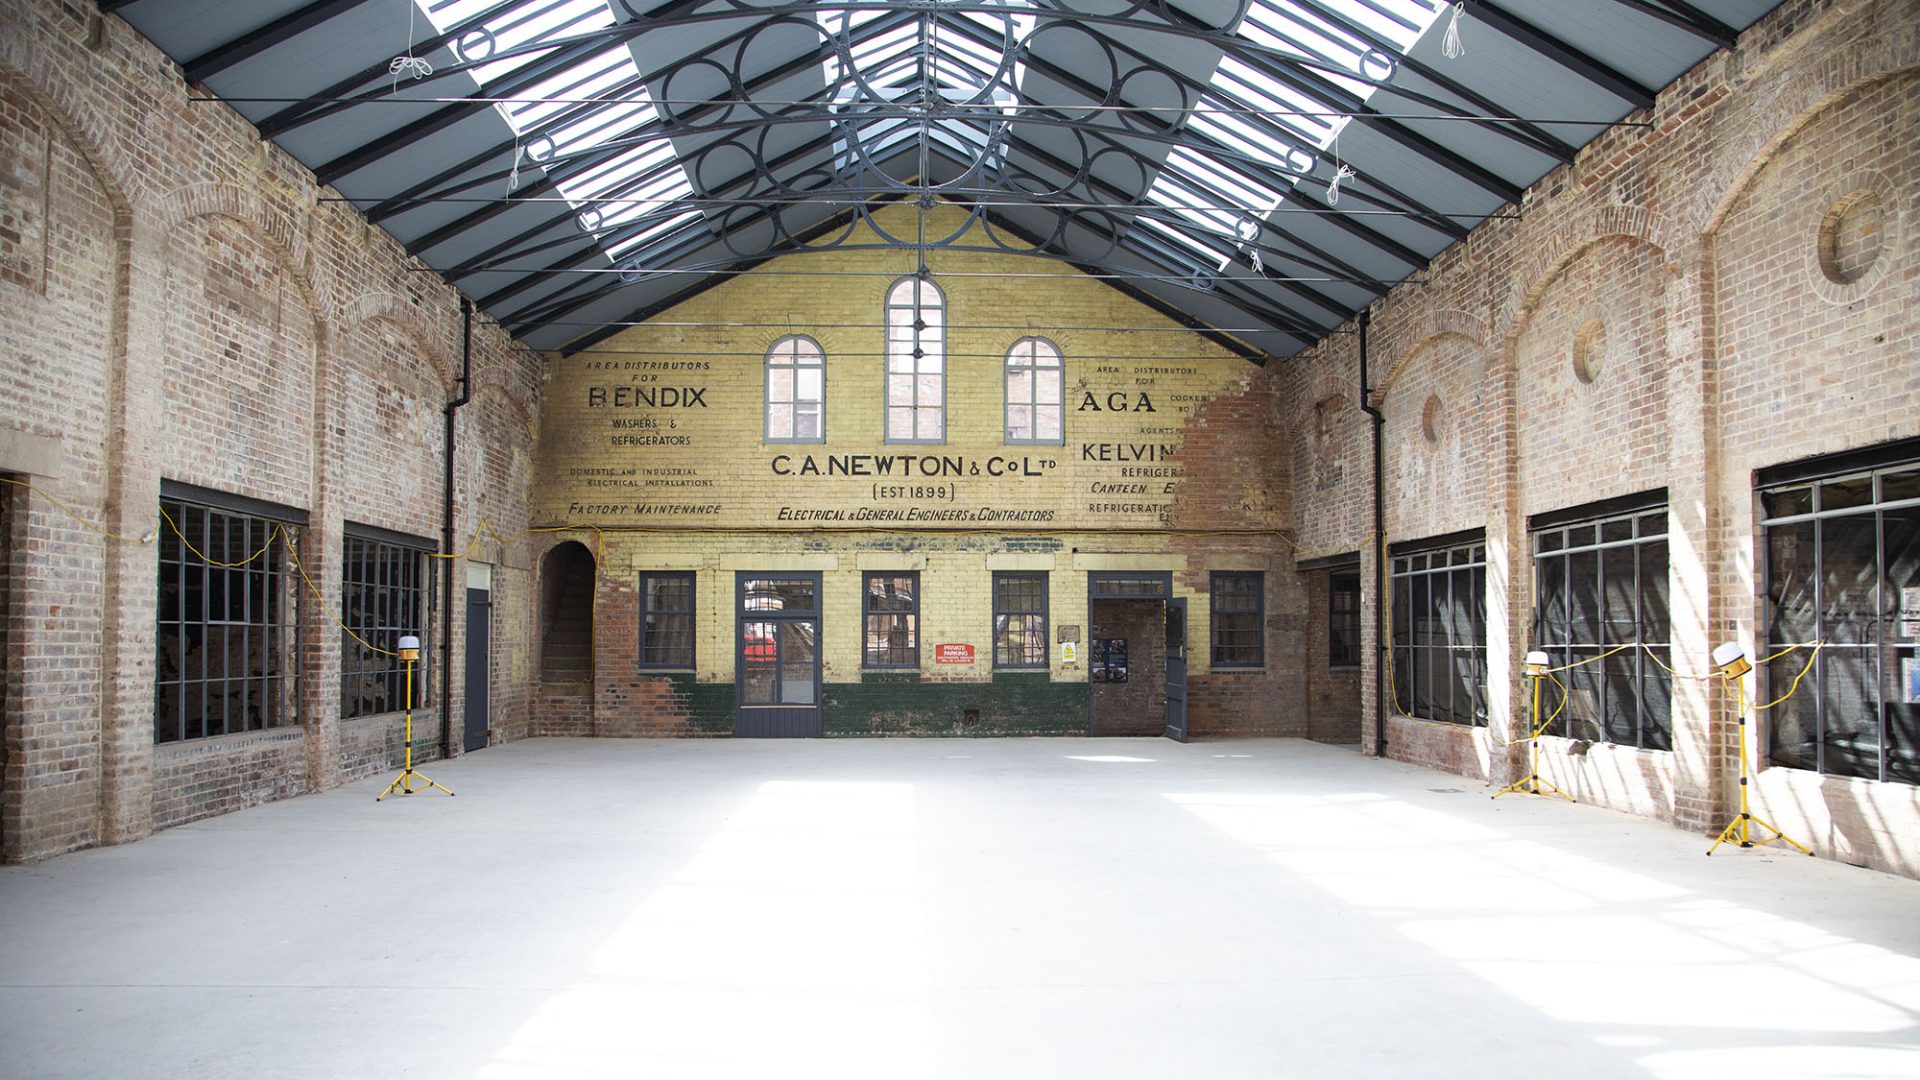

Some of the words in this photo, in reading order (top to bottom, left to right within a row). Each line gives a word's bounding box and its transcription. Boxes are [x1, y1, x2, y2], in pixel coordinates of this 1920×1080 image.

[586, 361, 619, 370] AREA
[624, 361, 710, 370] DISTRIBUTORS
[1134, 367, 1198, 375] DISTRIBUTORS
[632, 374, 658, 382] FOR
[588, 387, 707, 408] BENDIX
[1078, 391, 1156, 412] AGA
[612, 419, 657, 429] WASHERS
[611, 435, 690, 446] REFRIGERATORS
[1083, 443, 1174, 461] KELVIN
[570, 468, 615, 476] DOMESTIC
[969, 461, 980, 475] &
[587, 479, 639, 487] ELECTRICAL
